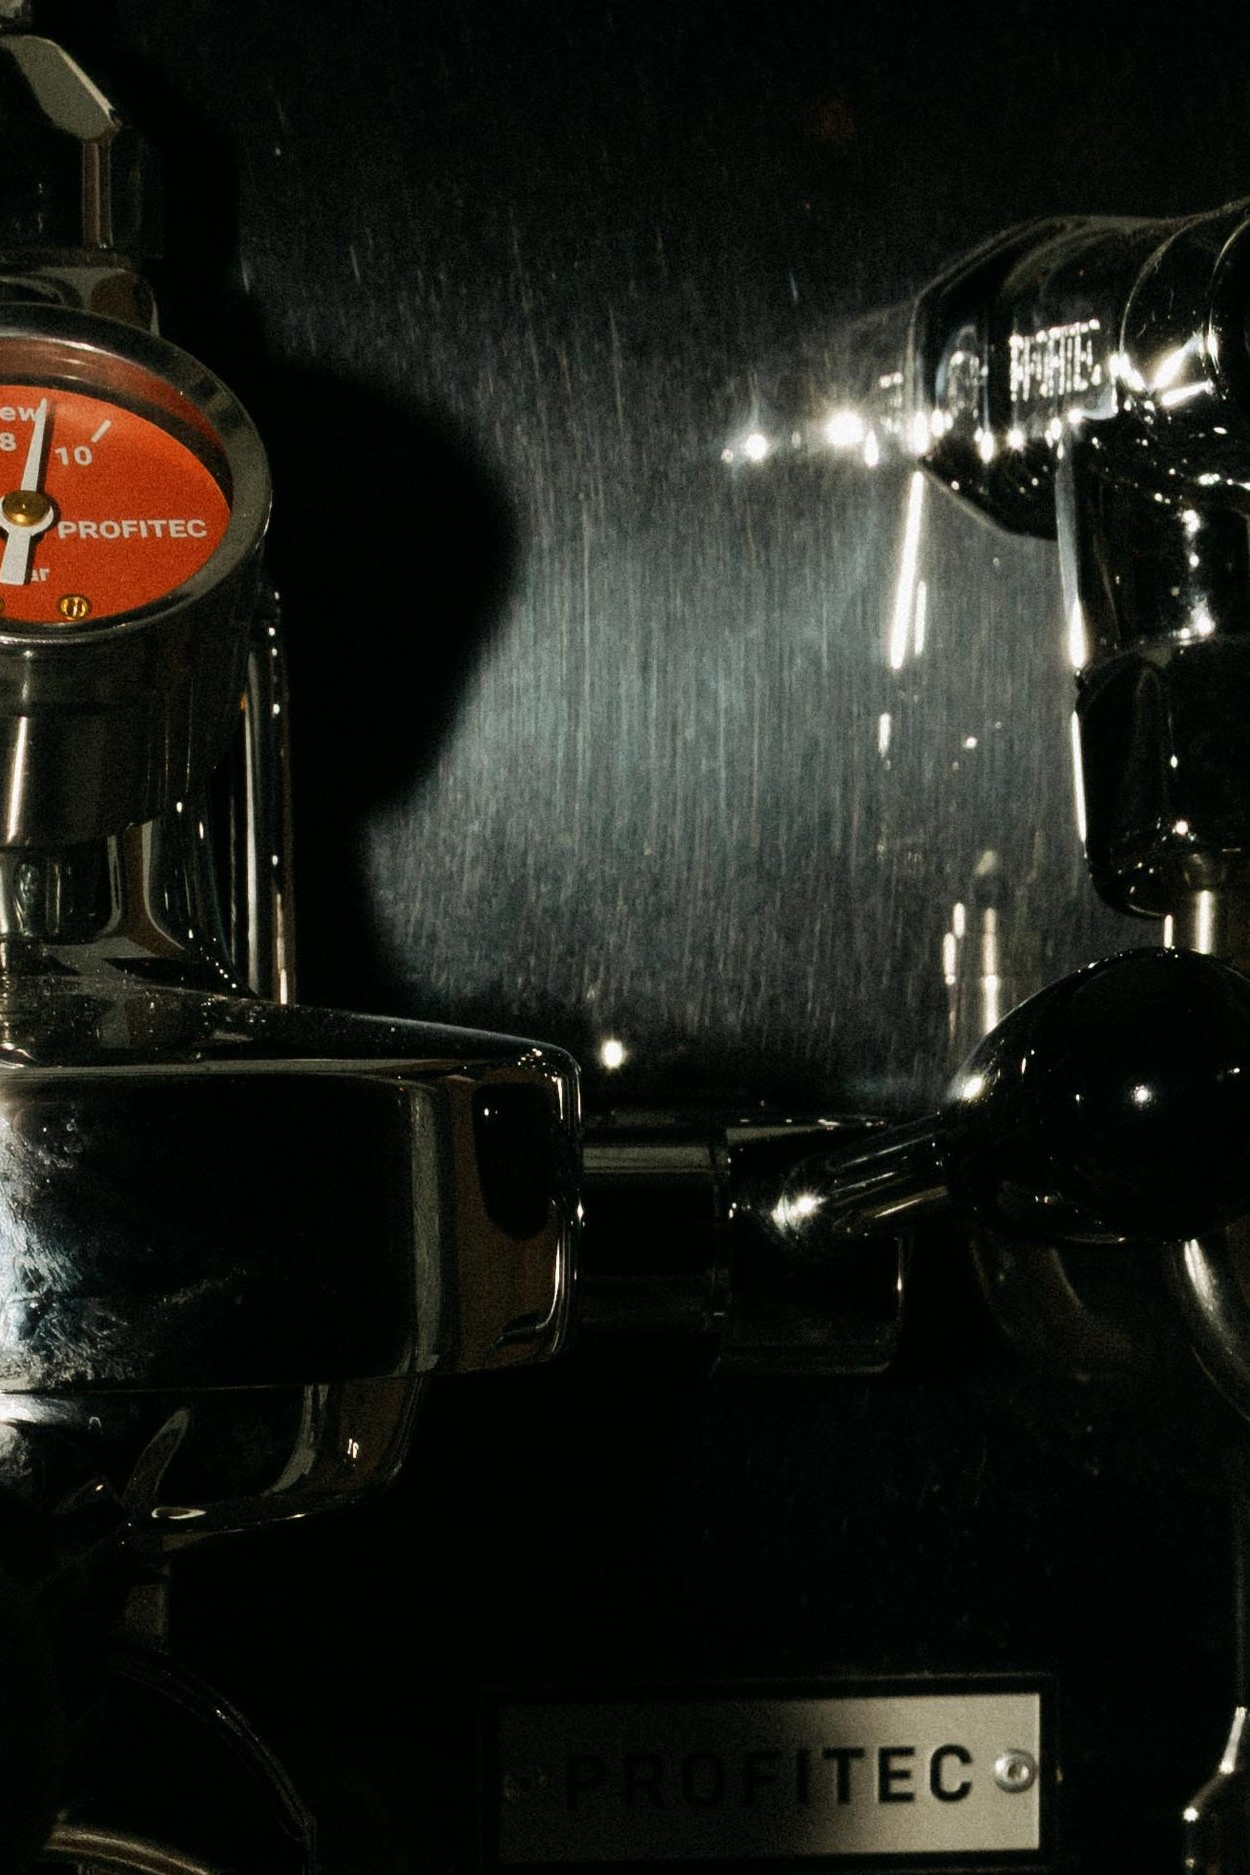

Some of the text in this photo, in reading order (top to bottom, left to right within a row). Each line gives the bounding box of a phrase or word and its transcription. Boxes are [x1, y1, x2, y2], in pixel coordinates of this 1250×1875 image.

[0, 432, 17, 451] 8
[54, 446, 93, 466] 10
[57, 519, 208, 539] PROFITEC
[30, 566, 50, 582] ar
[566, 1744, 973, 1811] PROFITEC
